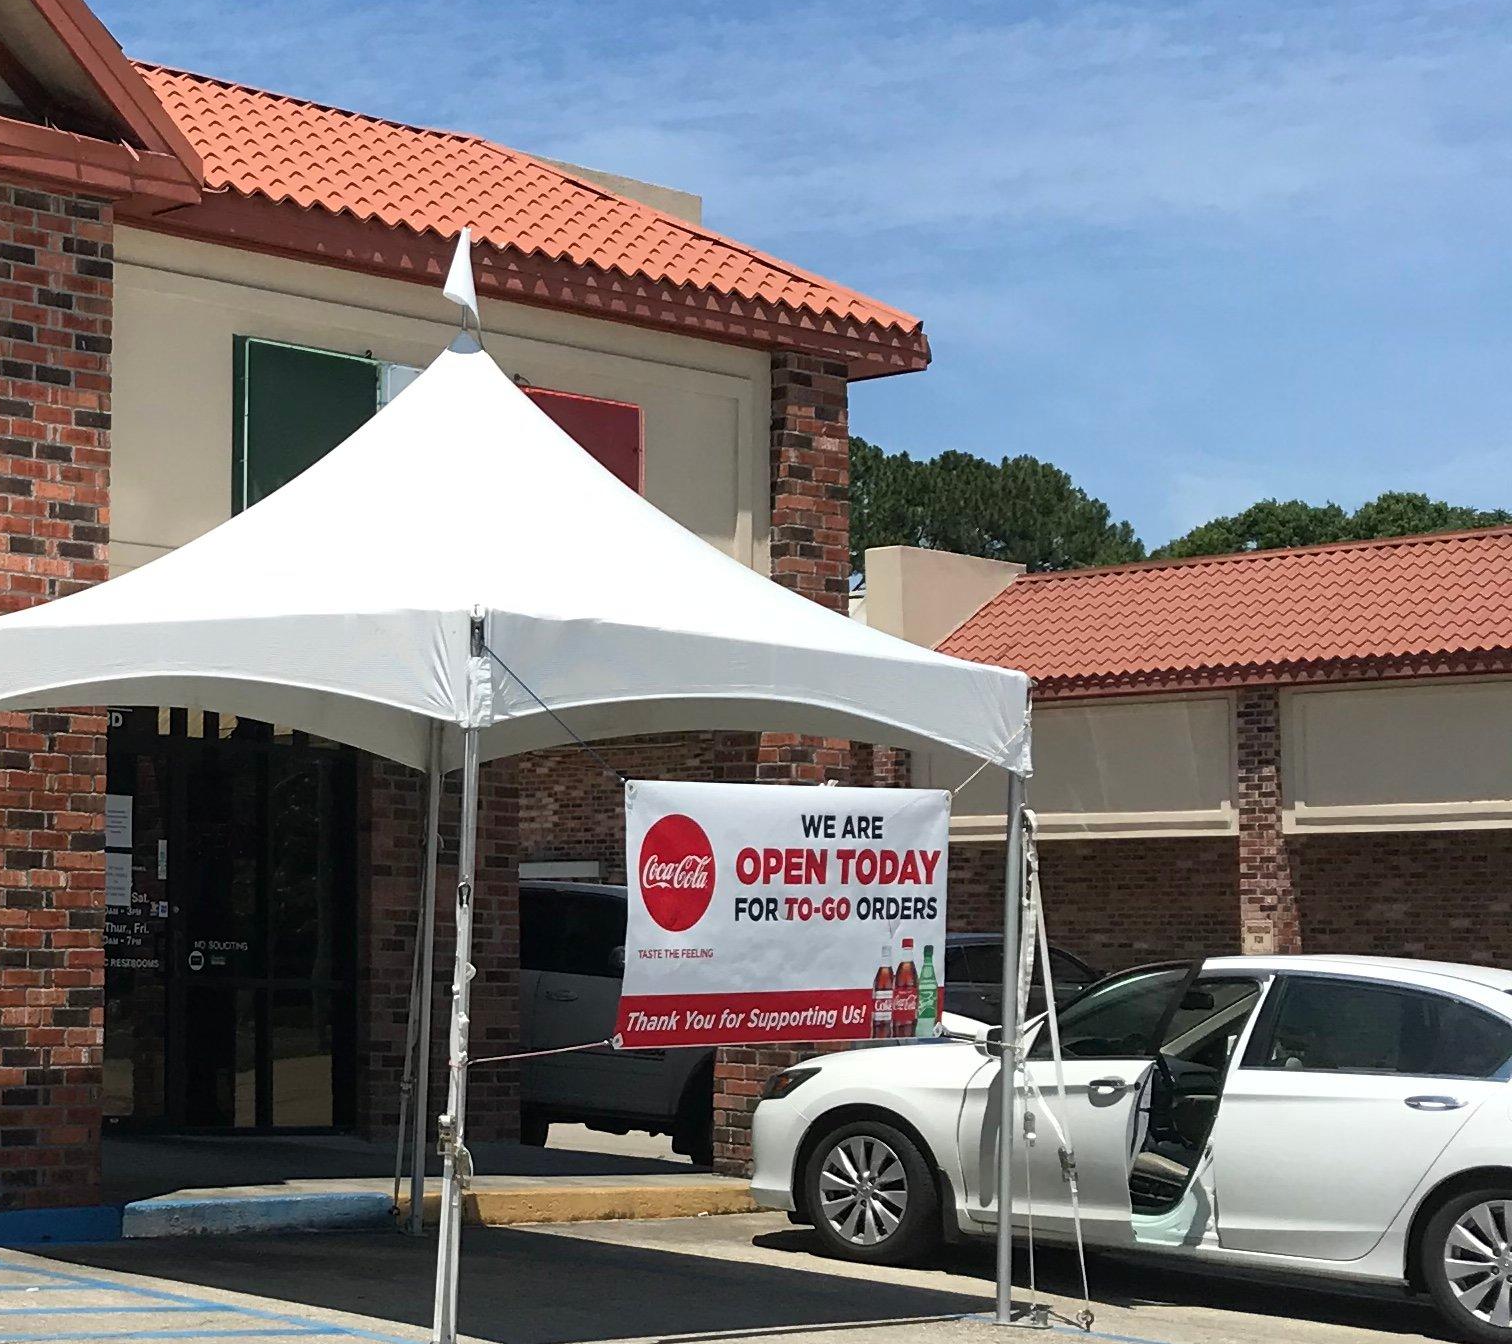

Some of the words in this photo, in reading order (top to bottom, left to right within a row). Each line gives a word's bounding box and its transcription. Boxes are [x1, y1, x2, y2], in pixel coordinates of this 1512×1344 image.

[801, 814, 836, 839] WE
[841, 815, 884, 840] ARE
[735, 847, 828, 886] OPEN
[835, 848, 942, 886] TODAY
[734, 897, 779, 922] FOR
[784, 897, 851, 922] TO-GO
[857, 896, 938, 921] ORDERS
[638, 949, 663, 959] TASTE
[664, 949, 680, 958] THE
[681, 948, 714, 958] FEELING
[627, 1010, 681, 1032] Thank
[682, 1008, 717, 1031] You
[721, 1007, 745, 1030] for
[747, 1004, 837, 1032] Supporting
[841, 1004, 867, 1025] Us!
